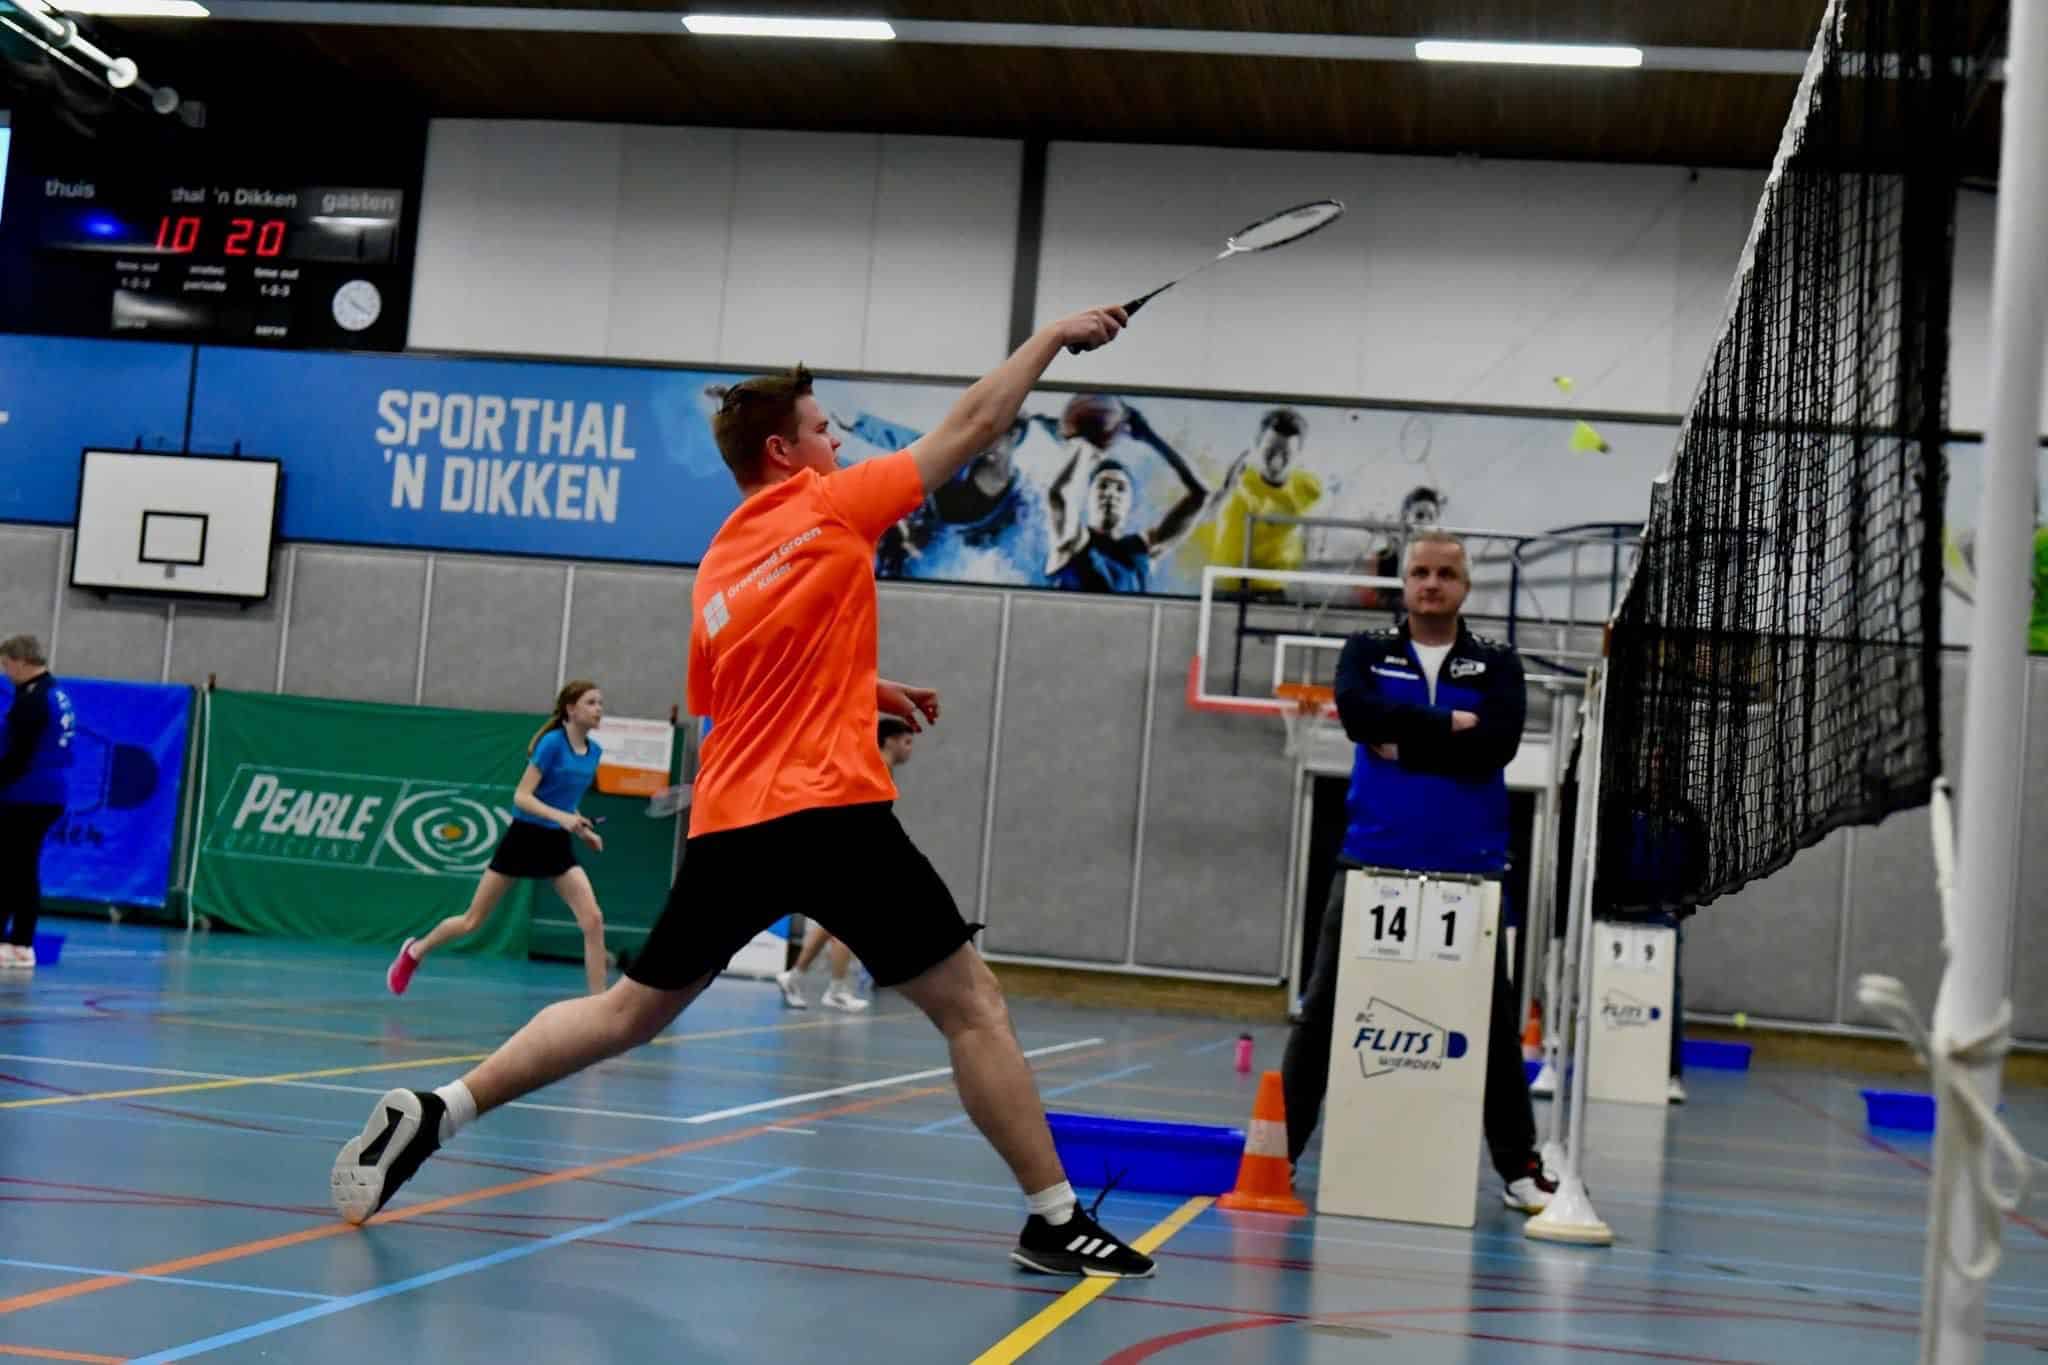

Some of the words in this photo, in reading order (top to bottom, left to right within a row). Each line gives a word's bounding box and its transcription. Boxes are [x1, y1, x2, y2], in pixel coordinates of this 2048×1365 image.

[45, 178, 96, 198] thuis
[234, 188, 298, 208] Dikken
[321, 191, 395, 213] gasten
[154, 216, 200, 253] 10
[224, 218, 286, 256] 20
[376, 389, 636, 460] SPORTHAL
[384, 449, 427, 509] 'N
[440, 456, 621, 523] DIKKEN
[779, 526, 823, 556] Groen
[232, 773, 383, 841] PEARLE
[1370, 904, 1407, 942] 14
[1441, 910, 1456, 947] 1
[1353, 1026, 1433, 1055] FLITS
